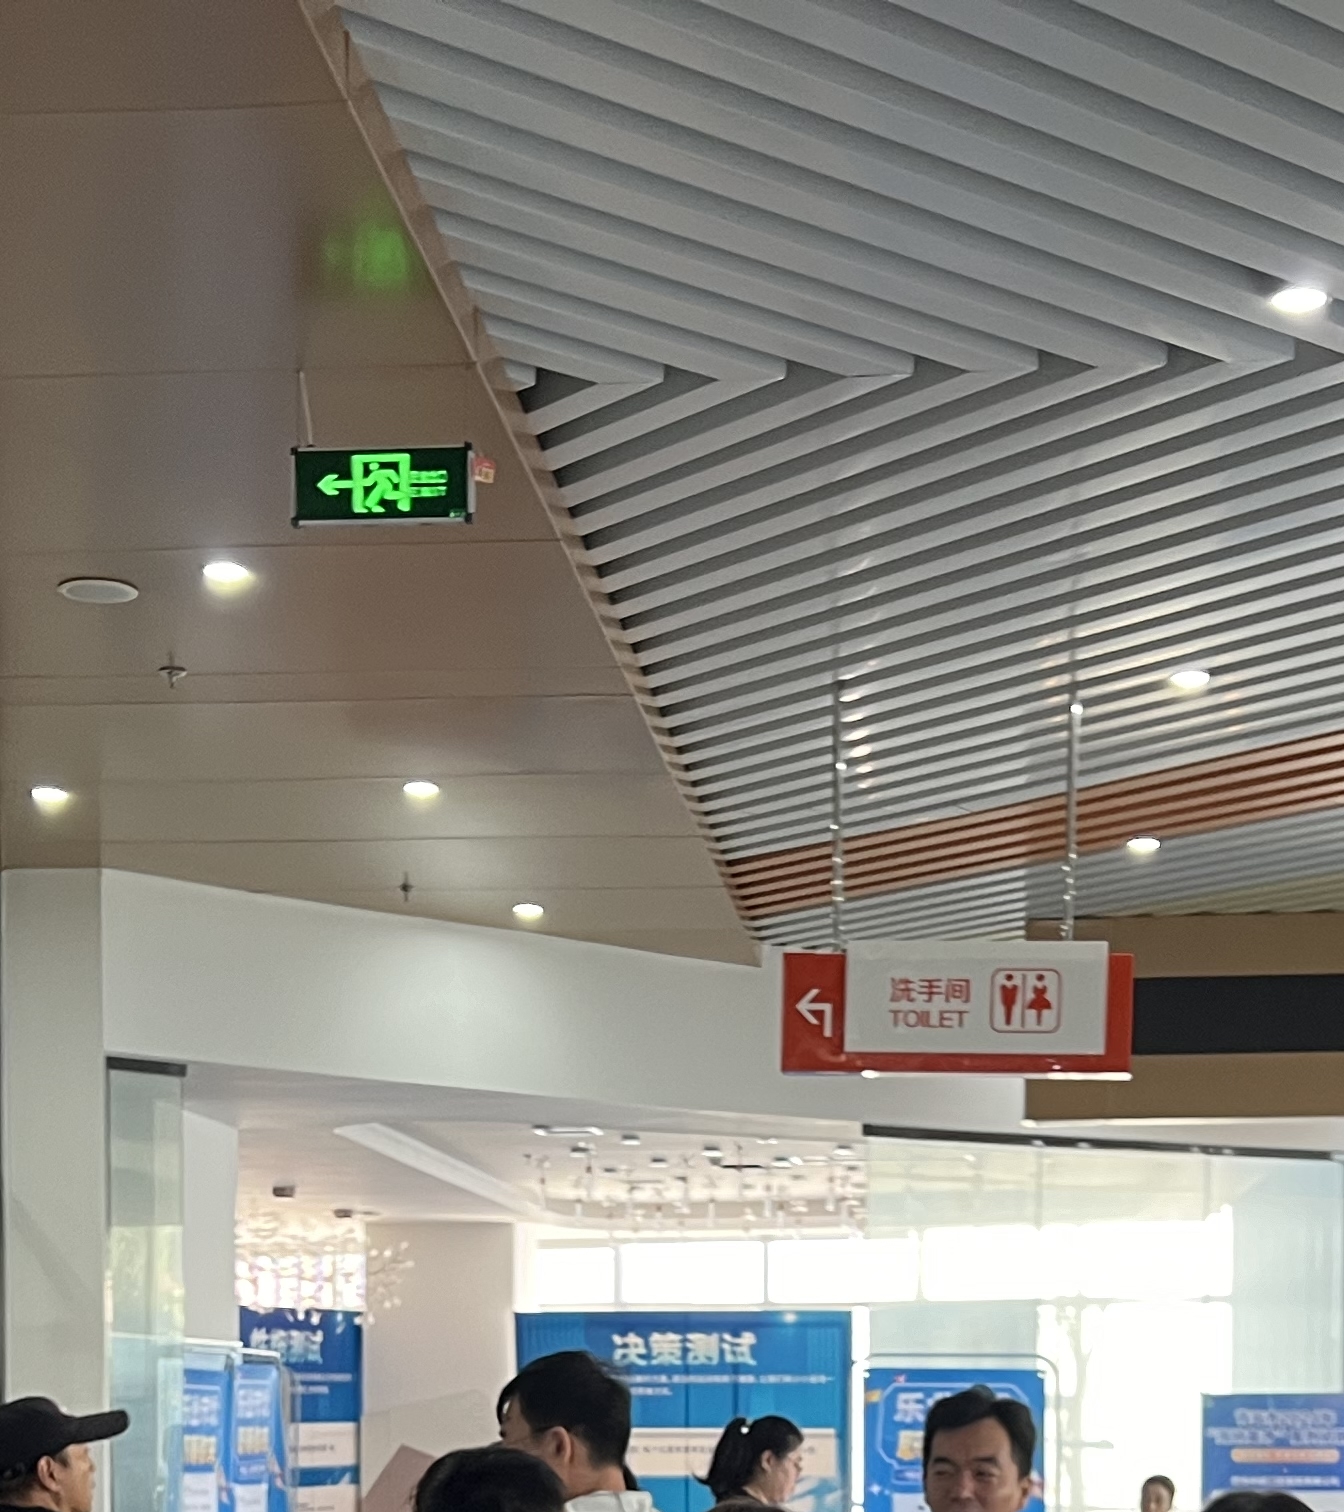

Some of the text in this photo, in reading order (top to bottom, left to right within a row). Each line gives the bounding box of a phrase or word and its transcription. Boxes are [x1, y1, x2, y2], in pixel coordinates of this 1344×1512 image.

[890, 977, 971, 1003] 洗手间
[888, 1009, 970, 1028] TOILET
[611, 1331, 758, 1366] 决策测试
